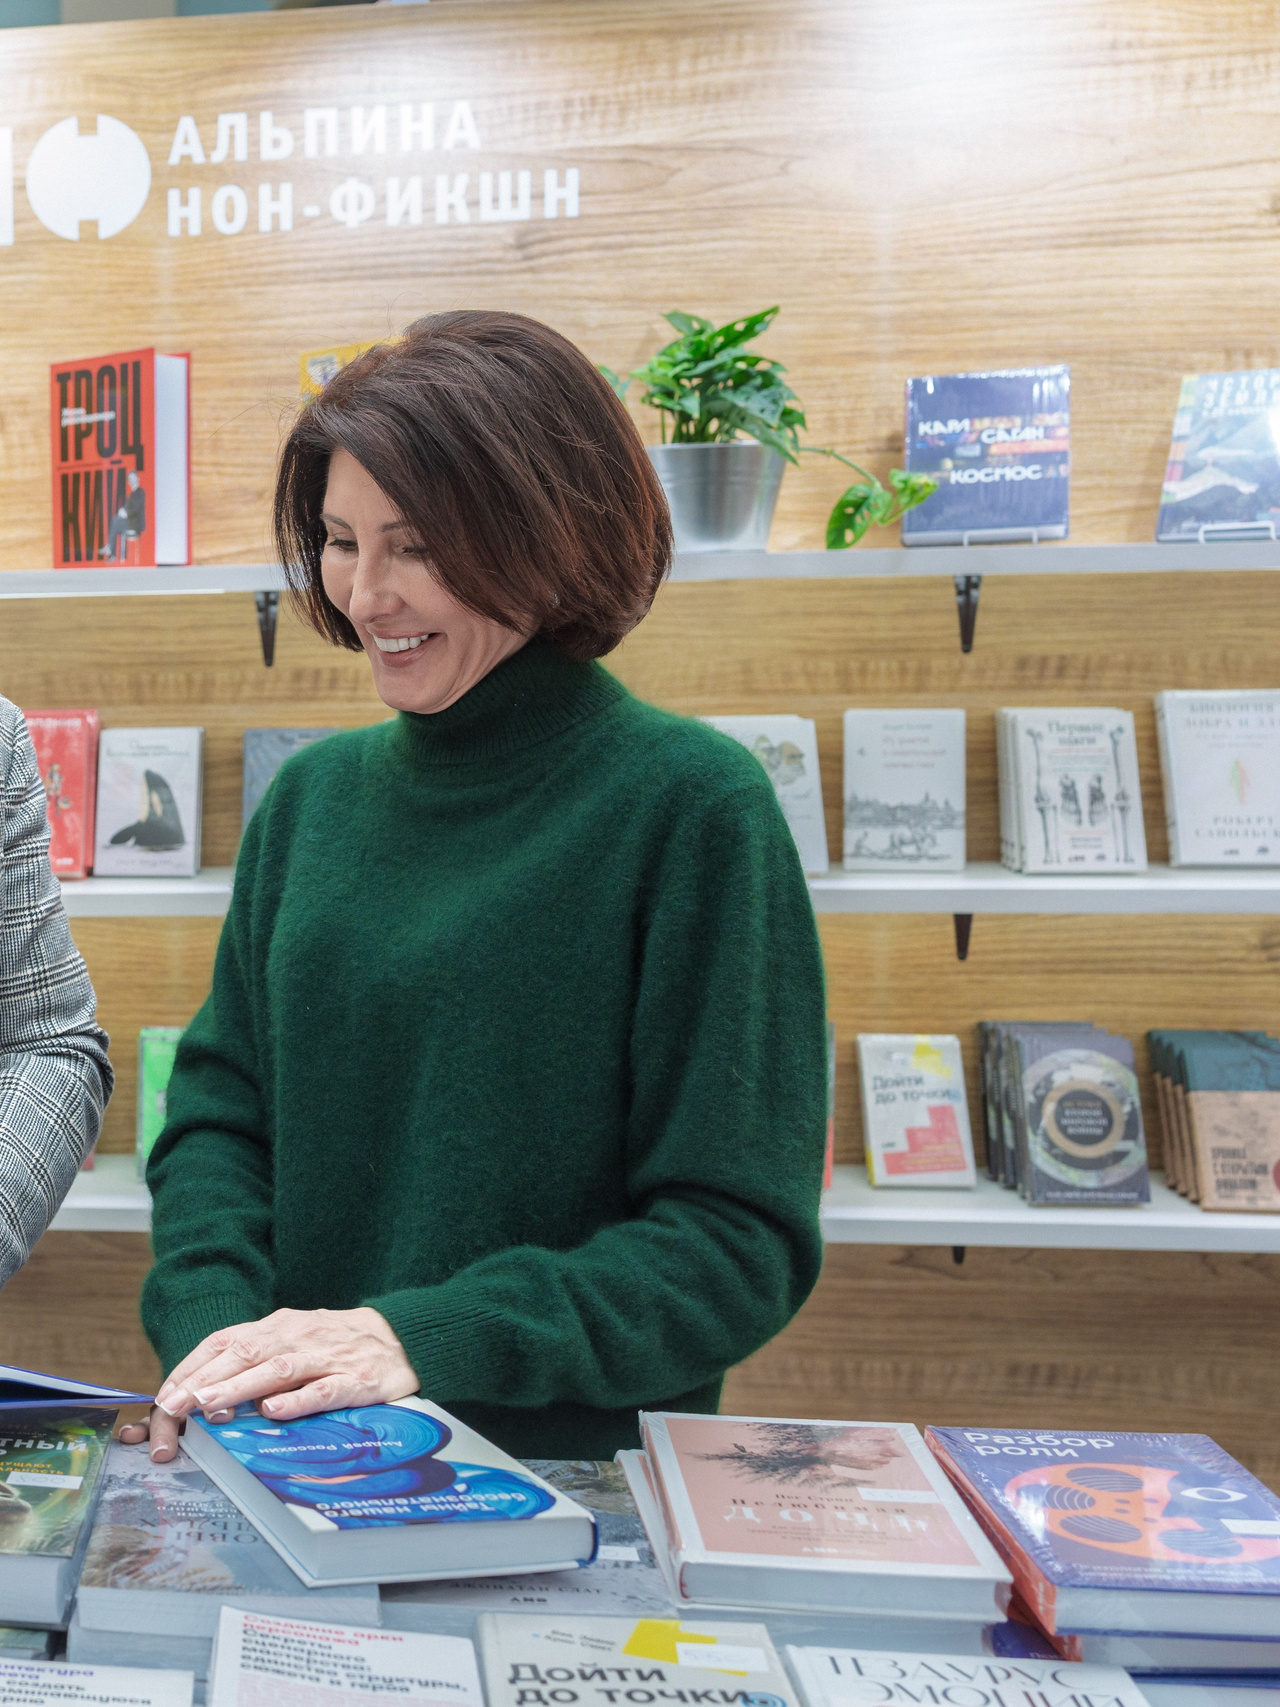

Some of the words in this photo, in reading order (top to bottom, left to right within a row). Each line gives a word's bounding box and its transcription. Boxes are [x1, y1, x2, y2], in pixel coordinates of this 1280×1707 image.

[167, 101, 481, 165] АЛЬПИНА
[167, 167, 580, 238] НОН-ФИКШН
[56, 360, 144, 470] ТРОЦ
[949, 465, 1043, 485] КОСМОС
[258, 1443, 338, 1454] Россохин
[341, 1440, 403, 1450] Андрей
[963, 1432, 1115, 1450] Разбор
[973, 1445, 1079, 1458] роли
[316, 1492, 526, 1510] бессознательного
[323, 1505, 412, 1518] нашего
[420, 1501, 496, 1513] Тайны
[176, 1531, 260, 1544] ОВЫ
[243, 1614, 345, 1637] Создание
[353, 1632, 404, 1643] арки
[243, 1622, 360, 1646] персонажа
[242, 1638, 366, 1663] сценарного
[243, 1629, 333, 1651] Секреты
[241, 1654, 339, 1677] единство
[507, 1662, 667, 1685] Дойти
[827, 1655, 1096, 1690] ТЕЗАУРУС
[6, 1679, 86, 1692] создать
[240, 1662, 321, 1683] сюжета
[350, 1681, 411, 1694] героя
[515, 1689, 579, 1706] до
